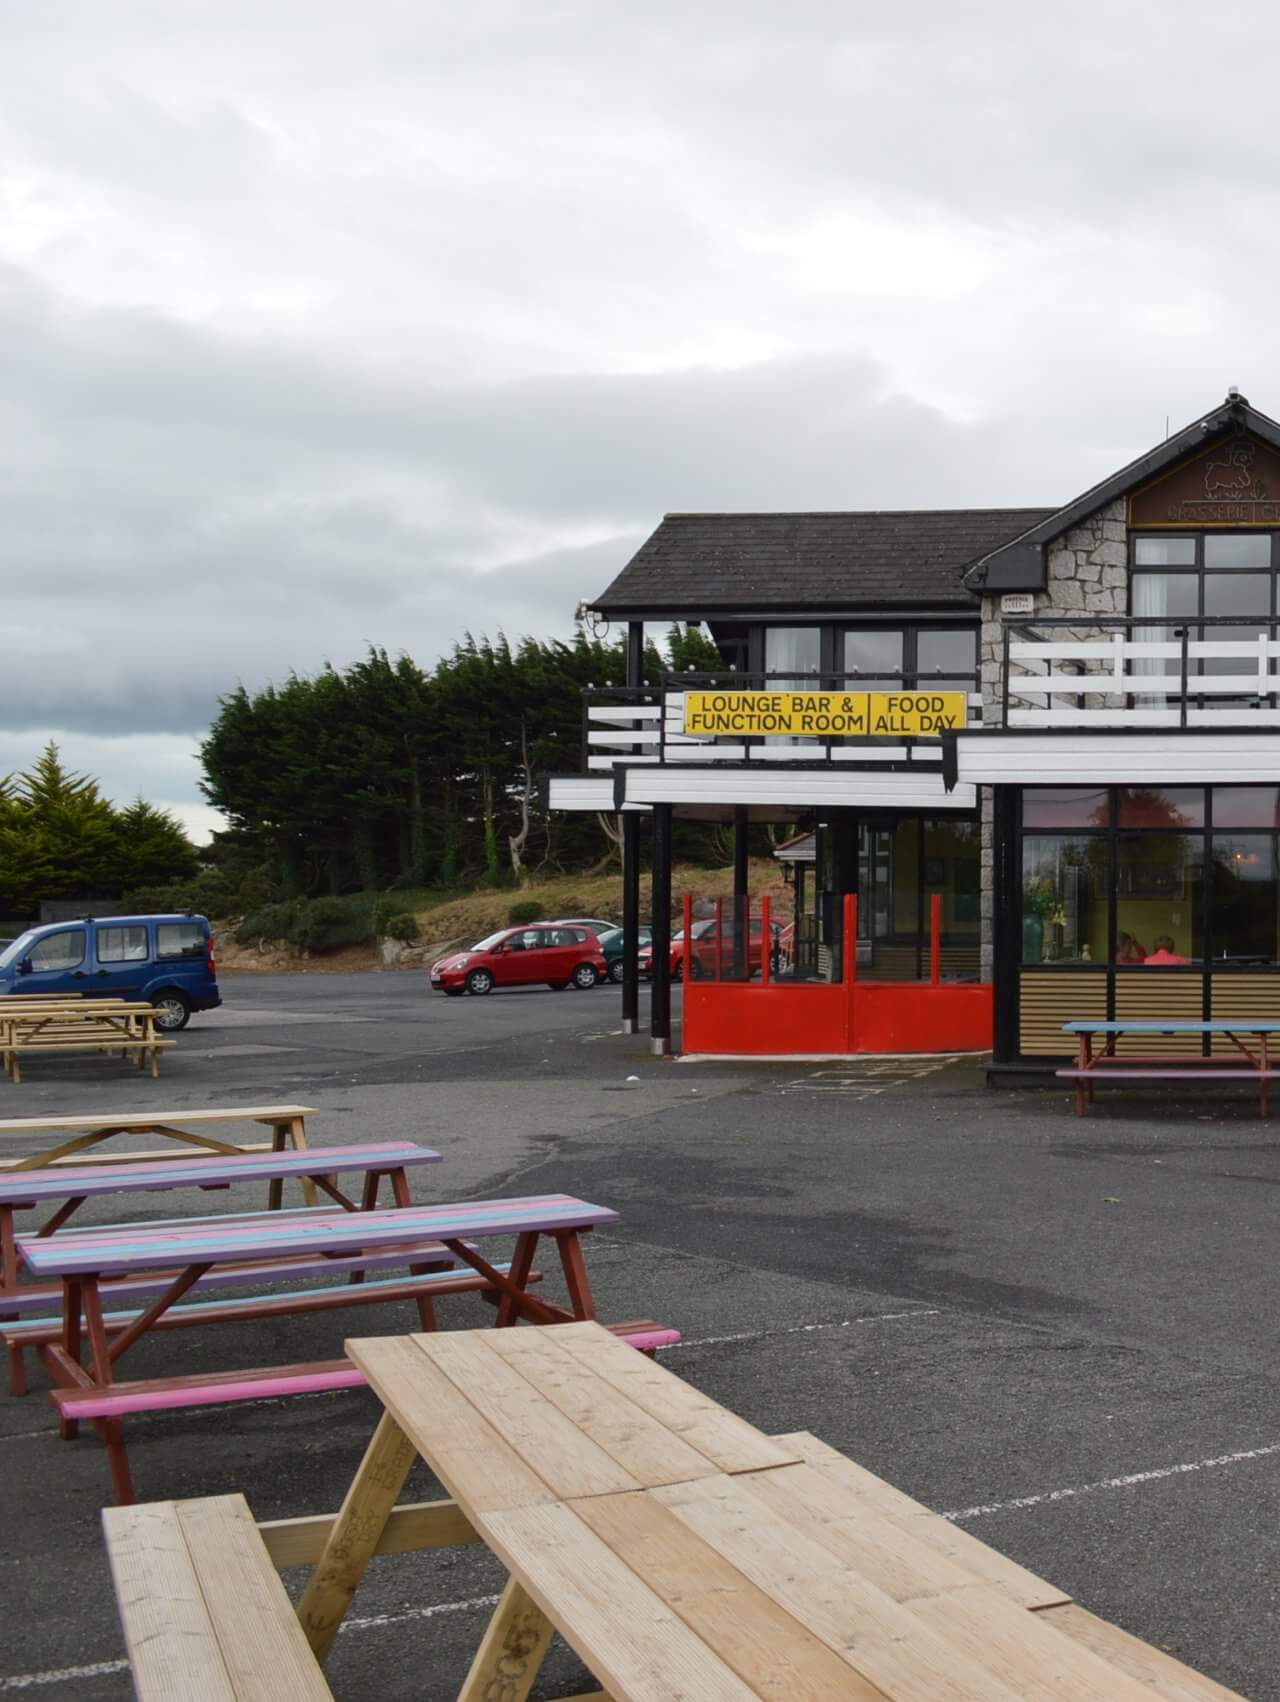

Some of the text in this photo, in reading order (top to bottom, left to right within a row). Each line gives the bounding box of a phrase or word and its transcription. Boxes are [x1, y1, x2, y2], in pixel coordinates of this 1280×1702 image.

[701, 696, 854, 713] LOUNGE BAR &
[887, 697, 945, 713] FOOD
[691, 714, 864, 731] FUNCTION ROOM
[875, 715, 957, 732] ALL DAY
